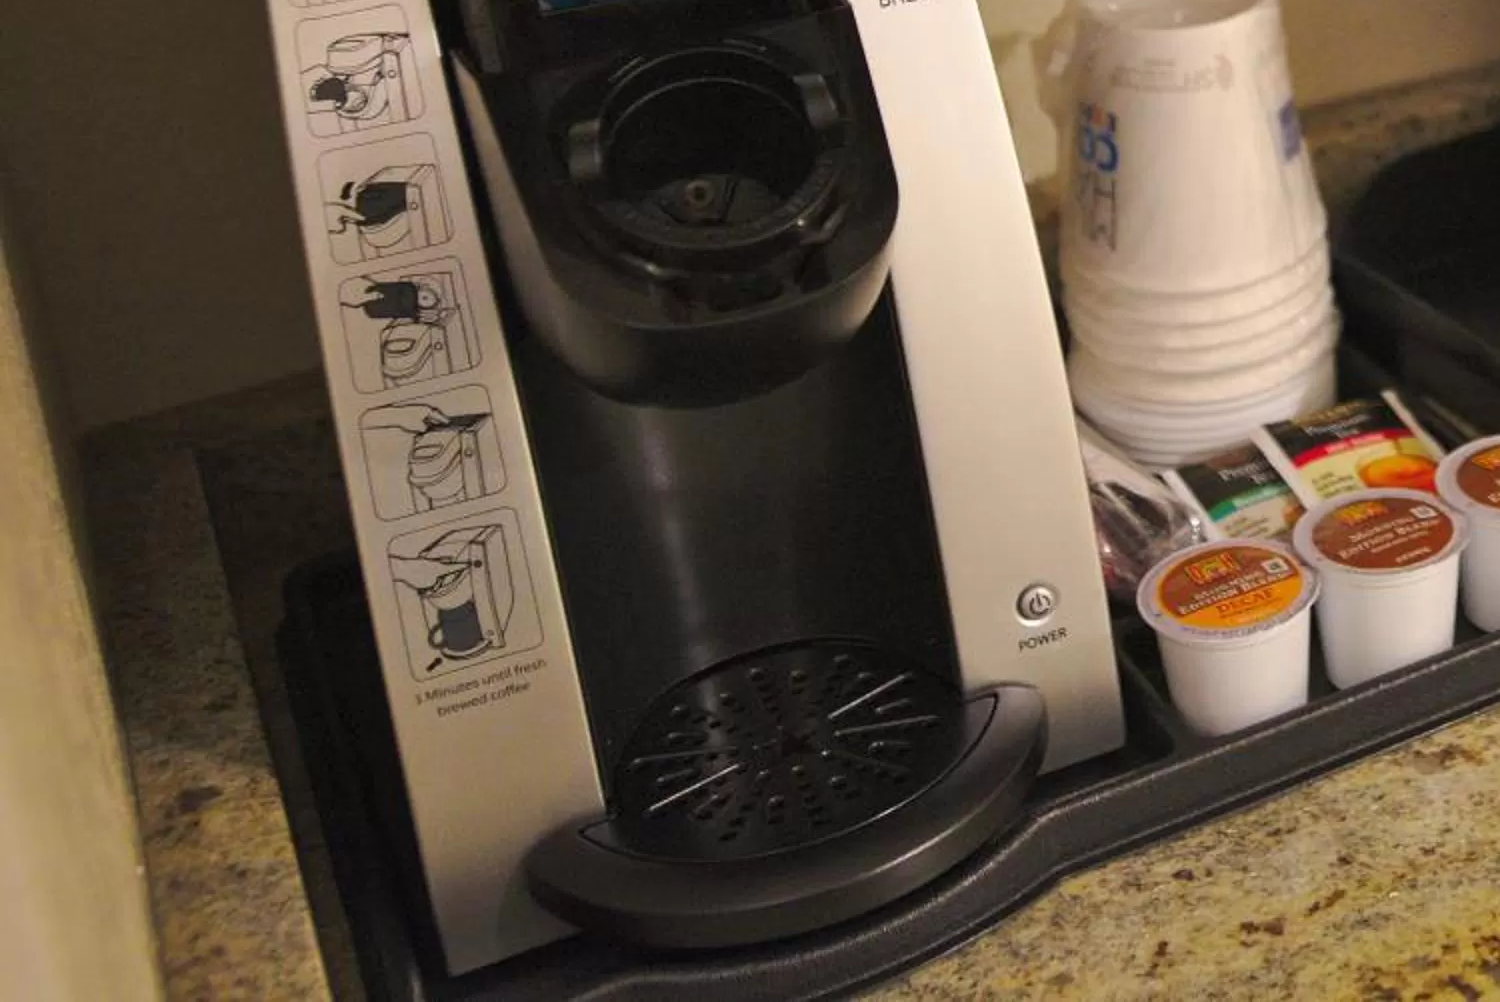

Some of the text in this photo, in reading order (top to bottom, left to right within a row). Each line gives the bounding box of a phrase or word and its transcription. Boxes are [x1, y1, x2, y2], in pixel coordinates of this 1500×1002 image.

[1215, 587, 1274, 614] DECAF
[1018, 626, 1068, 653] POWER
[513, 658, 547, 676] fresh
[436, 682, 532, 718] brewed coffee
